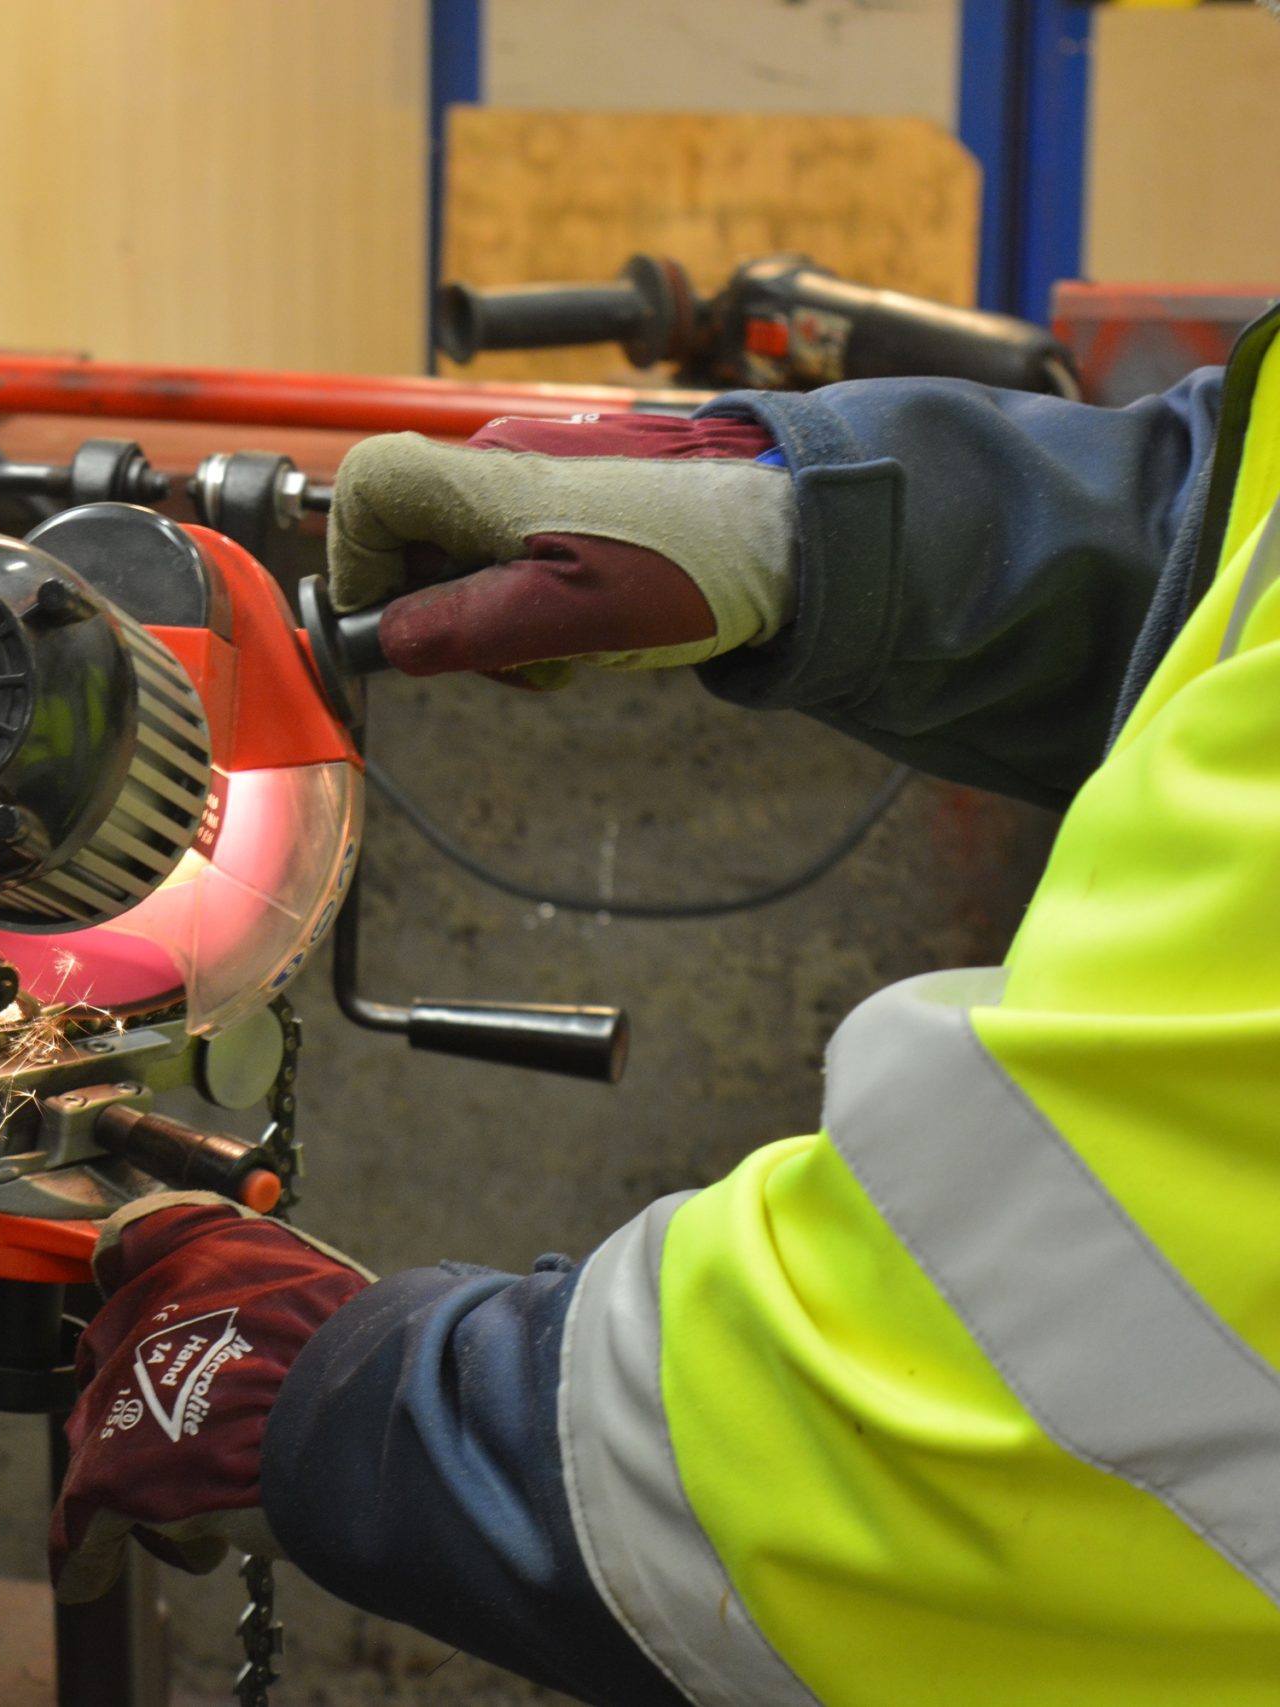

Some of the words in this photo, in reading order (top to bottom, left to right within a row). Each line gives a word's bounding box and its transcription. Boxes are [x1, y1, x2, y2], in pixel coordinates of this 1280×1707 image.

[147, 1341, 172, 1364] 1A
[160, 1334, 208, 1386] Hand
[184, 1334, 253, 1435] Macrolite
